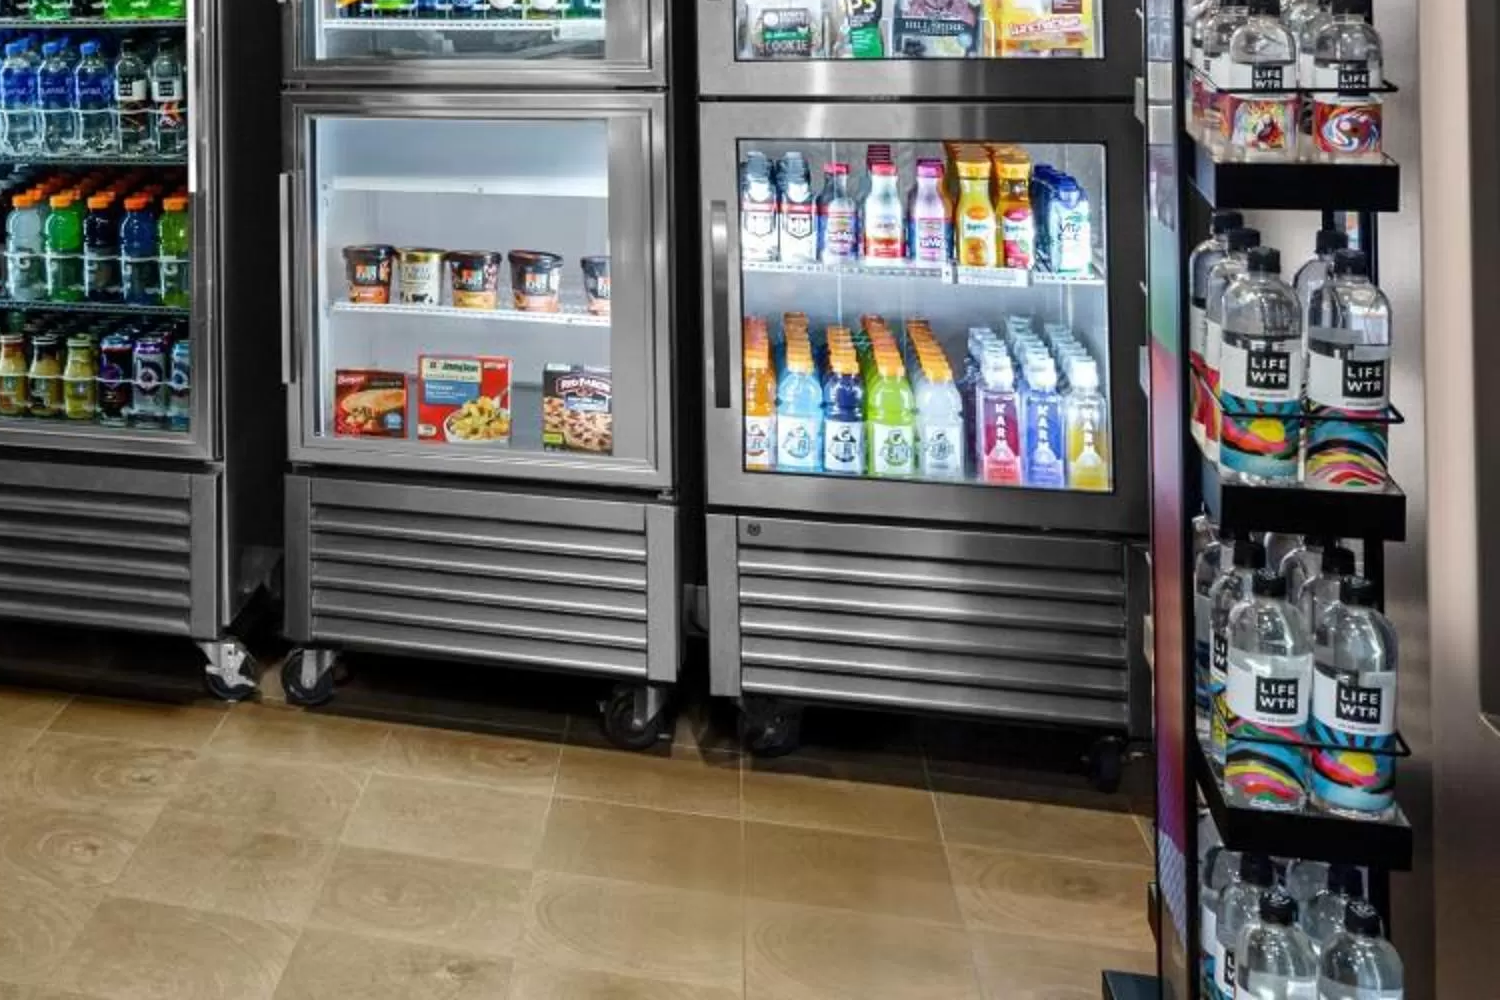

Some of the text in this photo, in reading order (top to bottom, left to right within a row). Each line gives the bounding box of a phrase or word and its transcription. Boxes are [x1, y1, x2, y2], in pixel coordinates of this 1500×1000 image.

[1254, 69, 1281, 79] LIFE
[1341, 73, 1367, 83] LIFE
[1251, 357, 1287, 369] LIFE
[1251, 371, 1287, 383] WTR
[1347, 365, 1382, 377] LIFE
[1346, 380, 1381, 391] WTR
[1259, 682, 1296, 696] LIFE
[1340, 688, 1378, 704] LIFE
[1259, 696, 1296, 710] WTR
[1339, 704, 1379, 719] WTR
